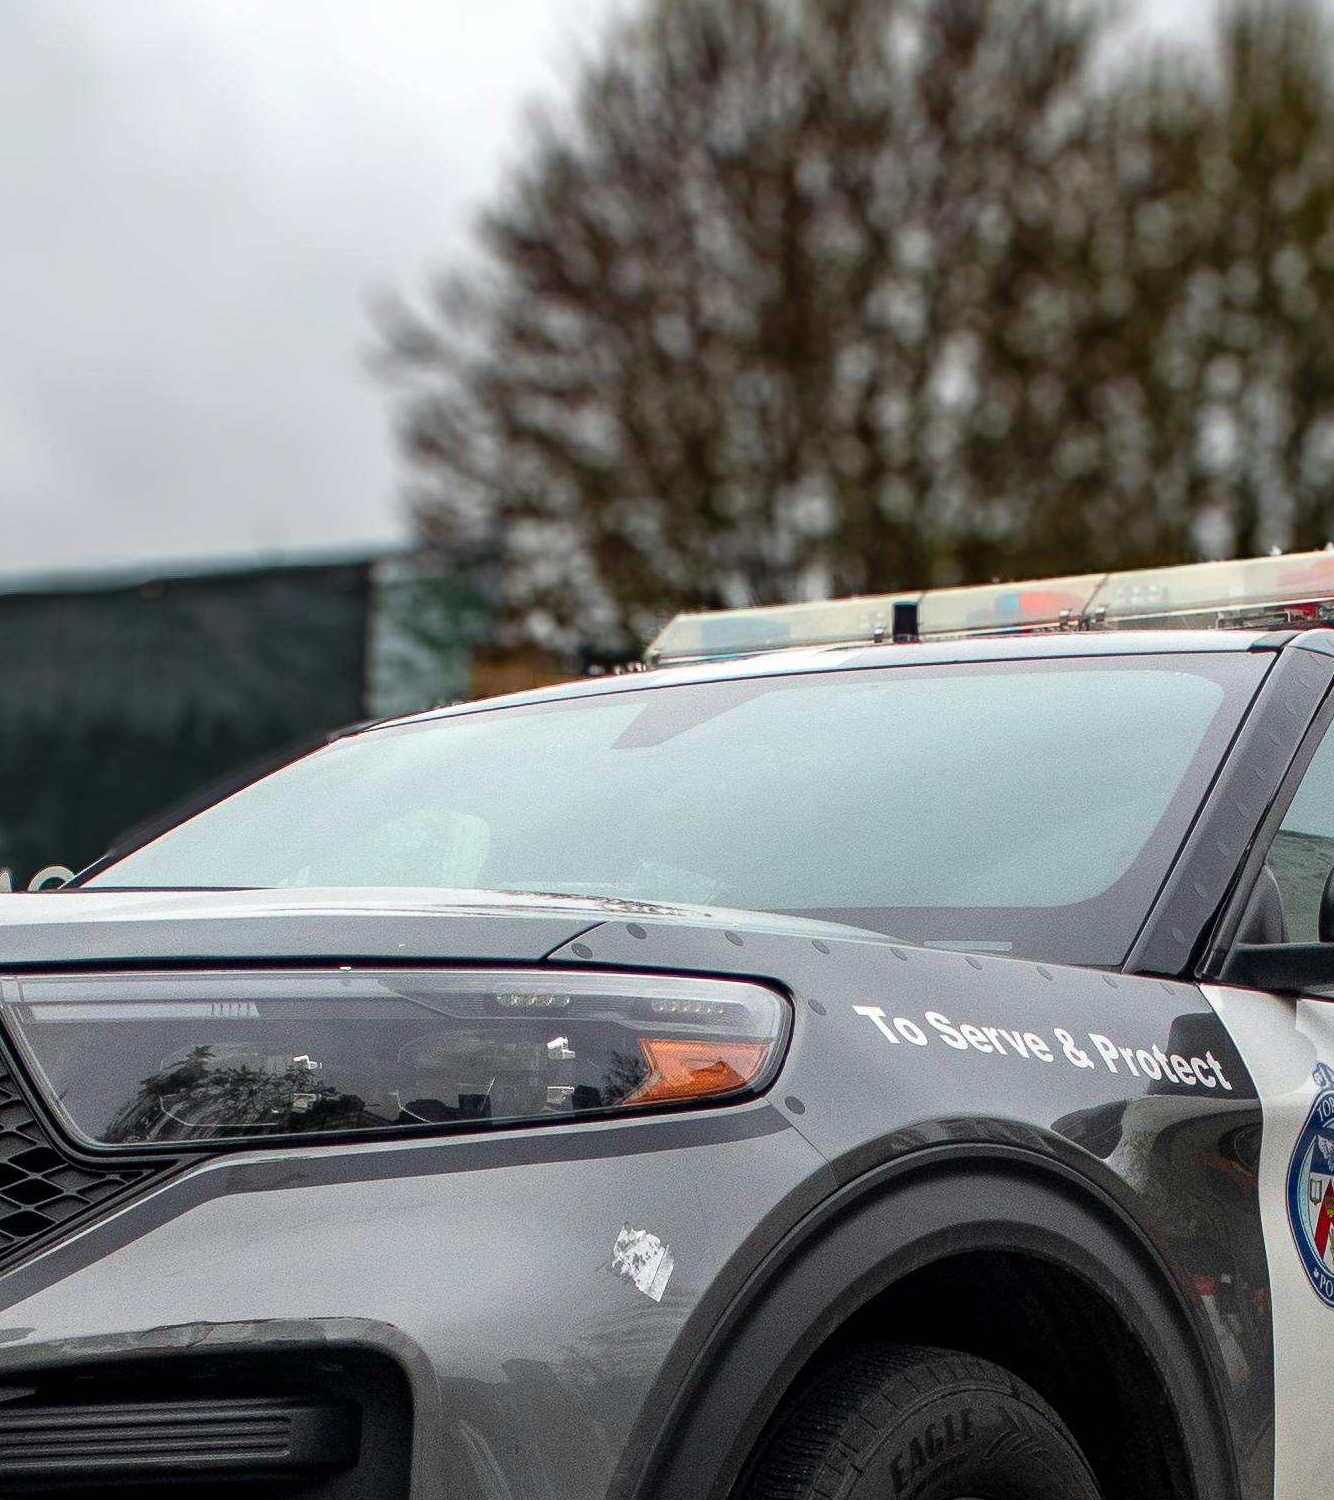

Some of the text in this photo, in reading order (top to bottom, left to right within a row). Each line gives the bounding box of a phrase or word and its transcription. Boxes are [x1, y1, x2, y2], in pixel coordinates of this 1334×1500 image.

[852, 1004, 1233, 1091] To Serve & Protect
[889, 1407, 974, 1496] EAGLE
